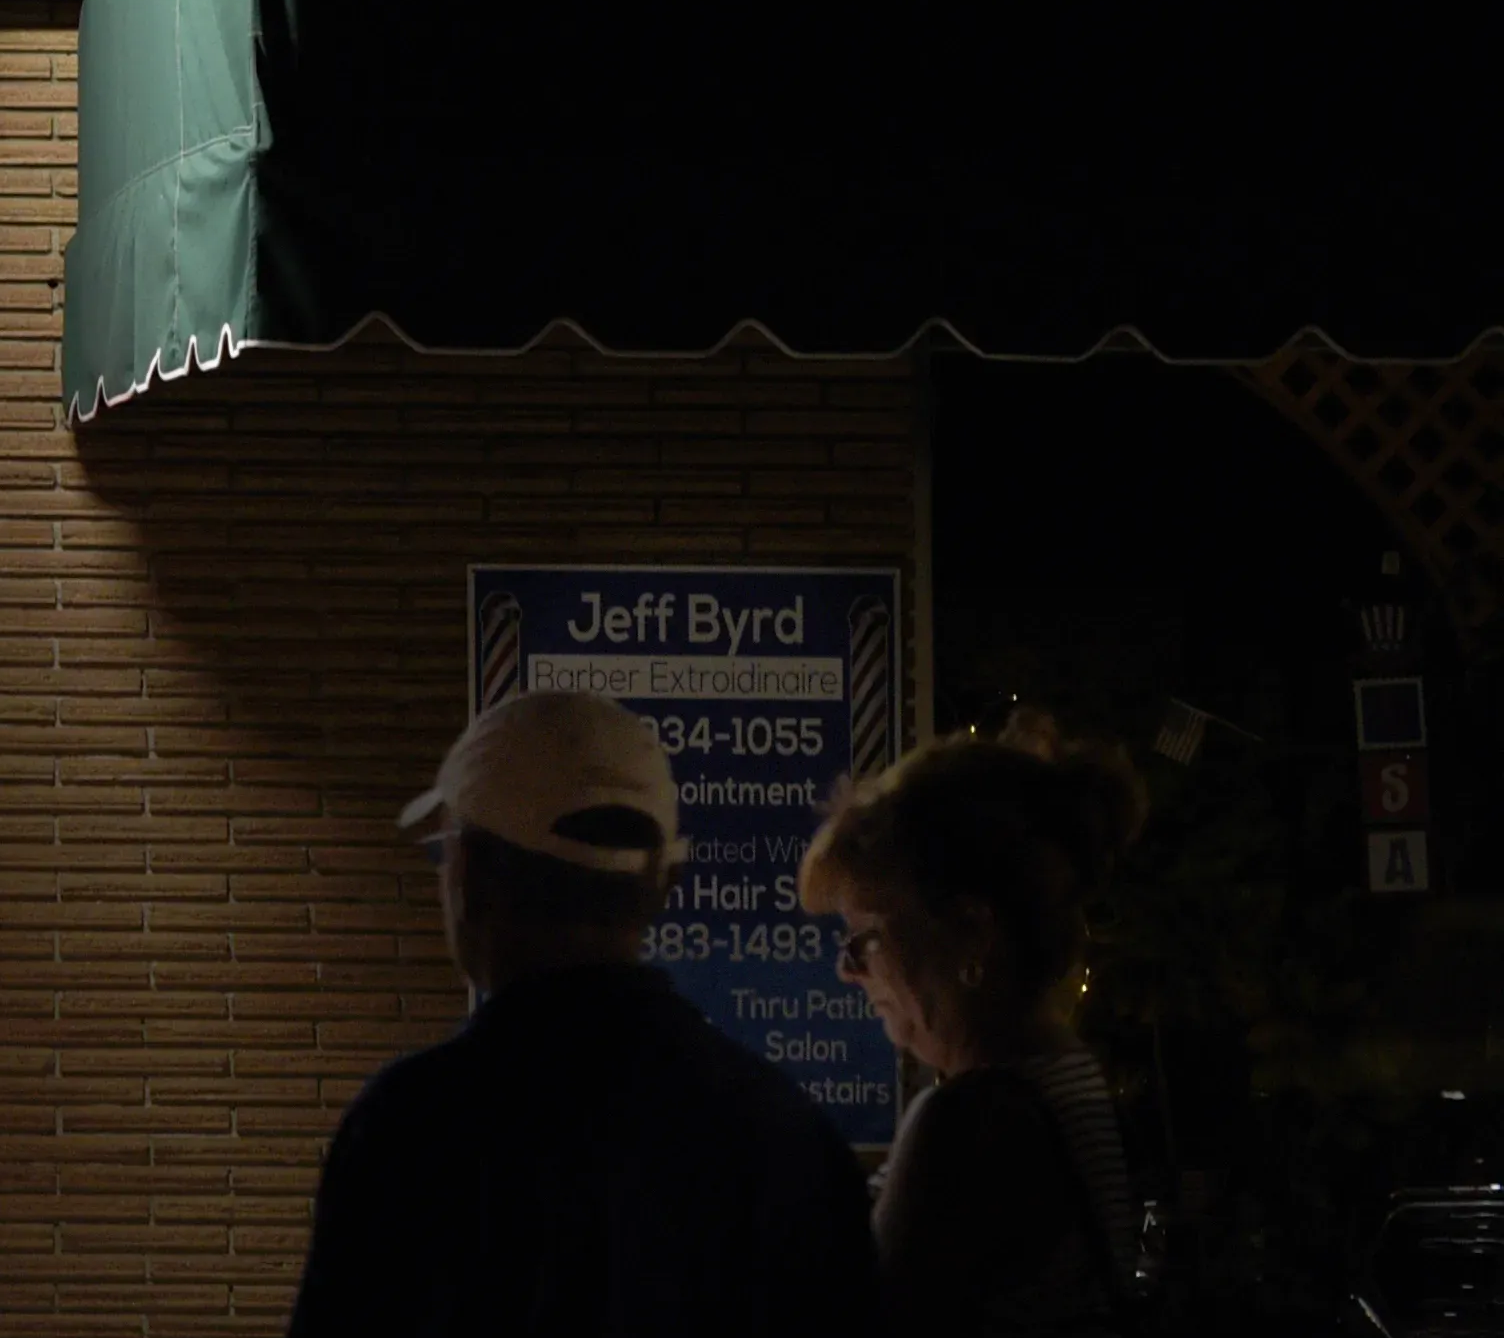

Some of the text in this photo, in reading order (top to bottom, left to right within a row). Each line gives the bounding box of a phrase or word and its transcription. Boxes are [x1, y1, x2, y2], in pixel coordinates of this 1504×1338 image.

[566, 592, 805, 656] Jeff Byrd
[534, 660, 838, 695] Barber Extroidinaire
[674, 773, 817, 806] ointment
[764, 835, 808, 864] Wit
[693, 873, 767, 911] Hair
[730, 988, 800, 1020] Thru
[764, 1029, 848, 1063] Salon
[799, 1074, 890, 1105] stairs
